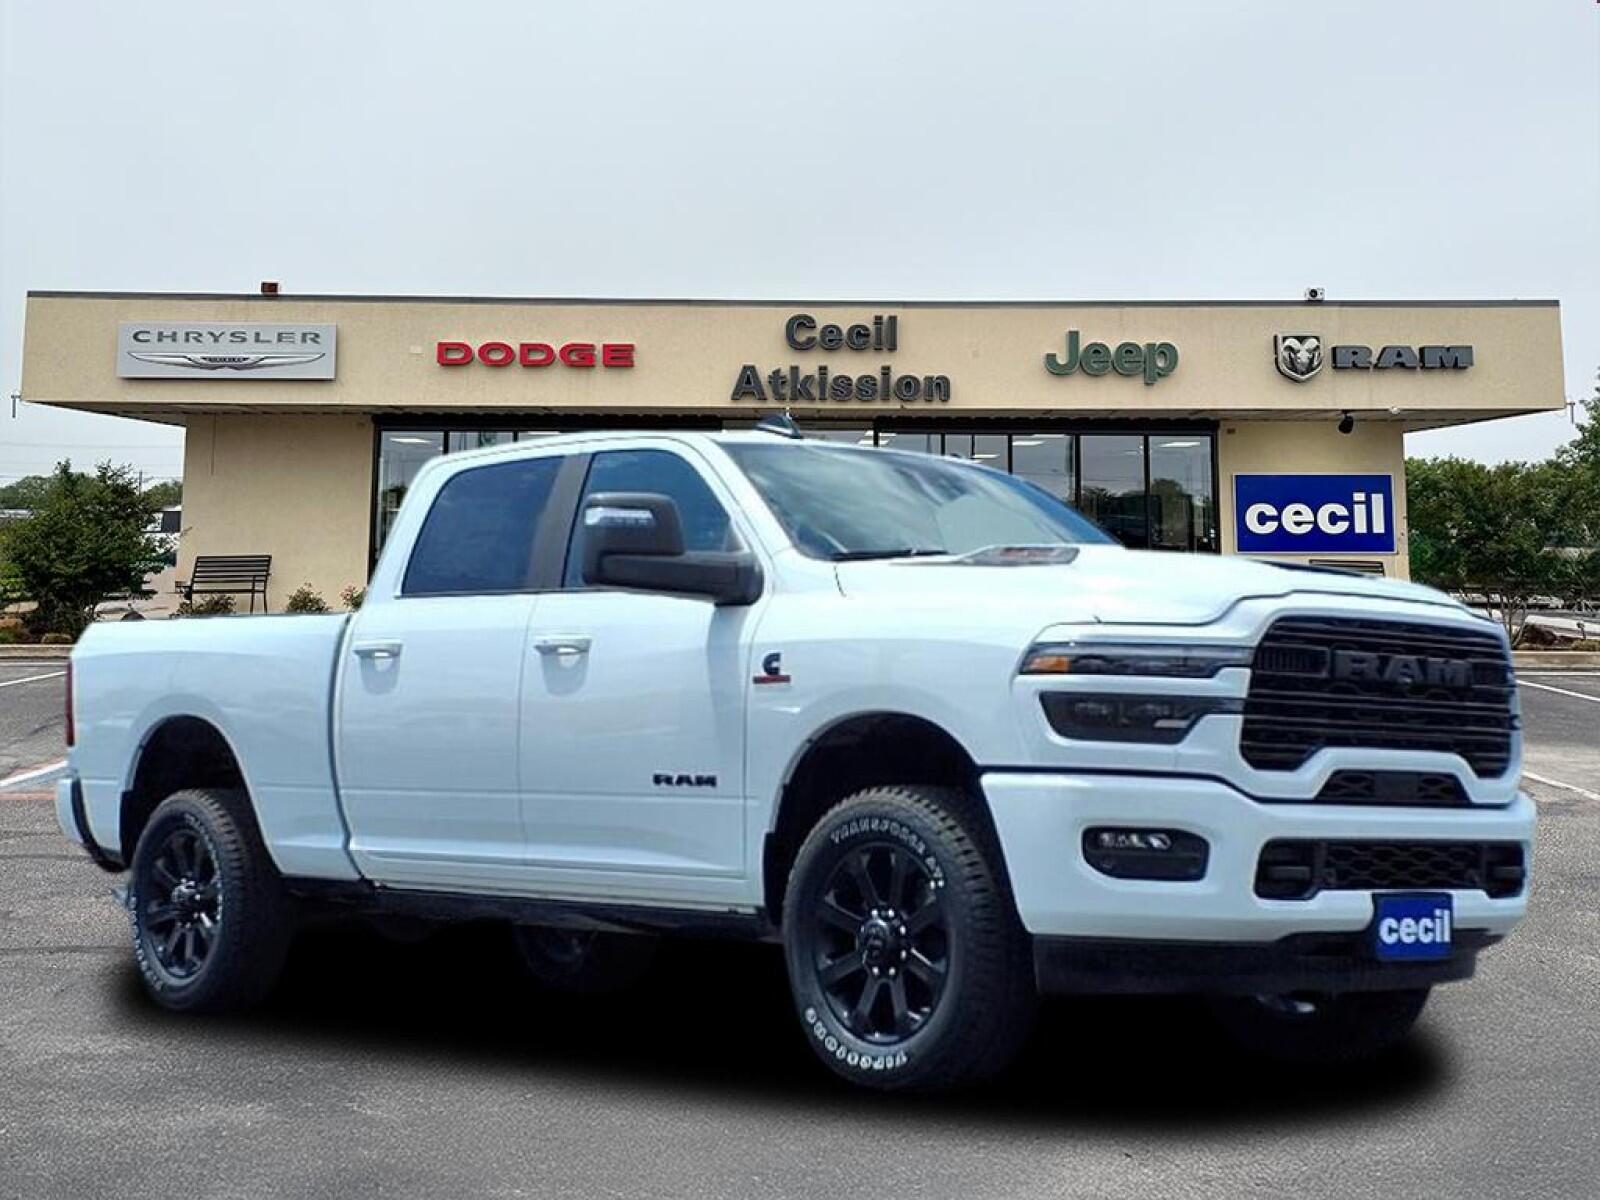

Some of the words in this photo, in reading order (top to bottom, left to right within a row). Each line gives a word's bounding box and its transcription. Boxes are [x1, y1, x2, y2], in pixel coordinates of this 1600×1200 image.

[132, 330, 321, 344] CHRYSLER
[785, 313, 898, 351] Cecil
[437, 342, 634, 367] DODGE
[1045, 330, 1179, 386] Jeep
[1332, 345, 1474, 369] RAM
[731, 364, 950, 401] Atkission
[1245, 491, 1385, 534] cecil
[1333, 650, 1473, 687] RAM
[652, 774, 717, 788] RAM
[1379, 908, 1451, 944] cecil
